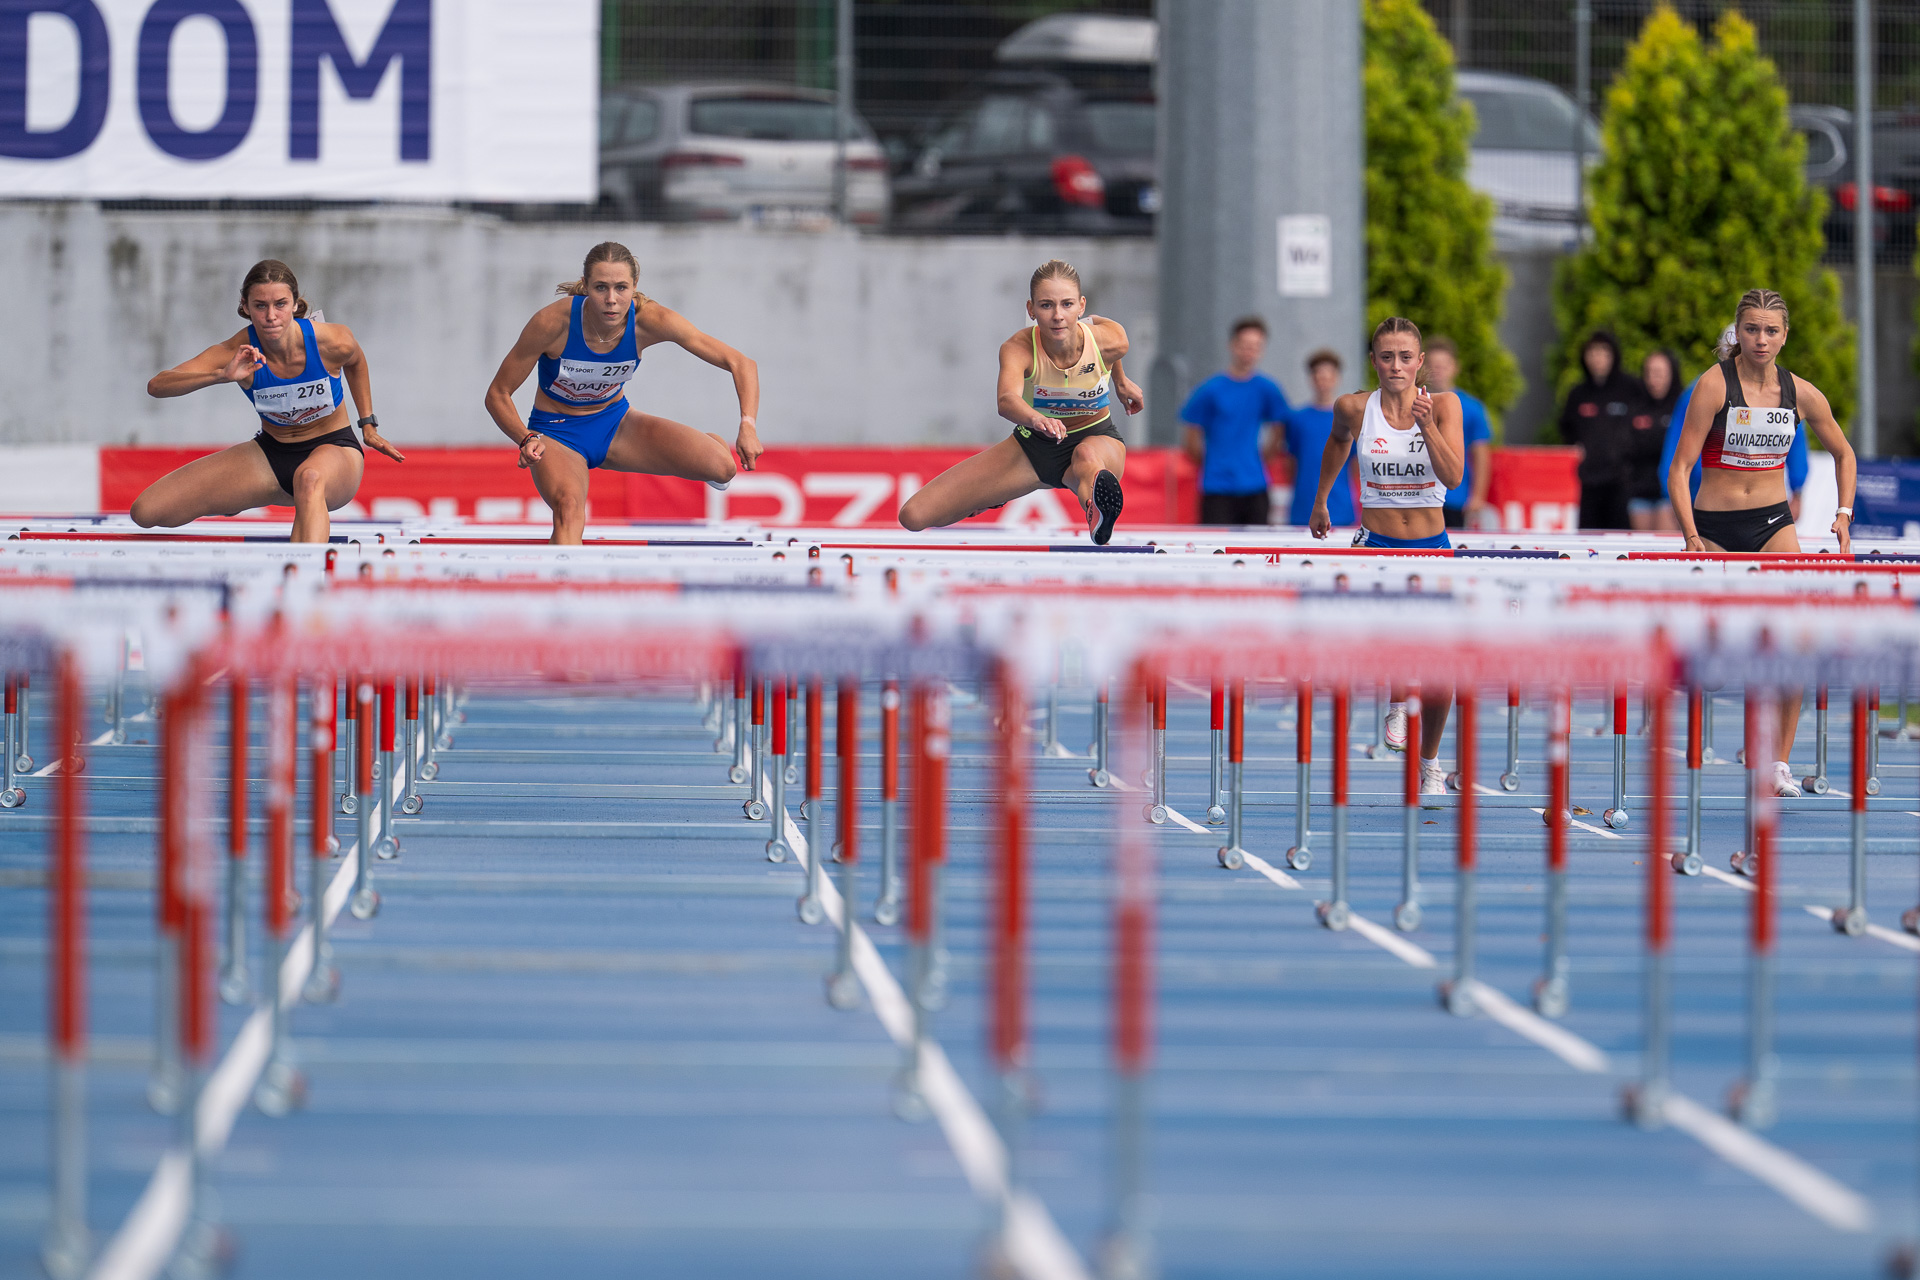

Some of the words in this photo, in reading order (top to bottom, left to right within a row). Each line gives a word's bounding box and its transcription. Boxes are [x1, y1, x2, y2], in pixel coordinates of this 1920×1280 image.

[602, 365, 630, 377] 279
[269, 392, 288, 400] SPORT
[297, 383, 325, 399] 278
[1078, 385, 1104, 398] 486
[1766, 412, 1789, 424] 306
[1727, 432, 1791, 447] GWIAZDECKA
[1737, 459, 1760, 467] RADOM
[1371, 462, 1425, 477] KIELAR
